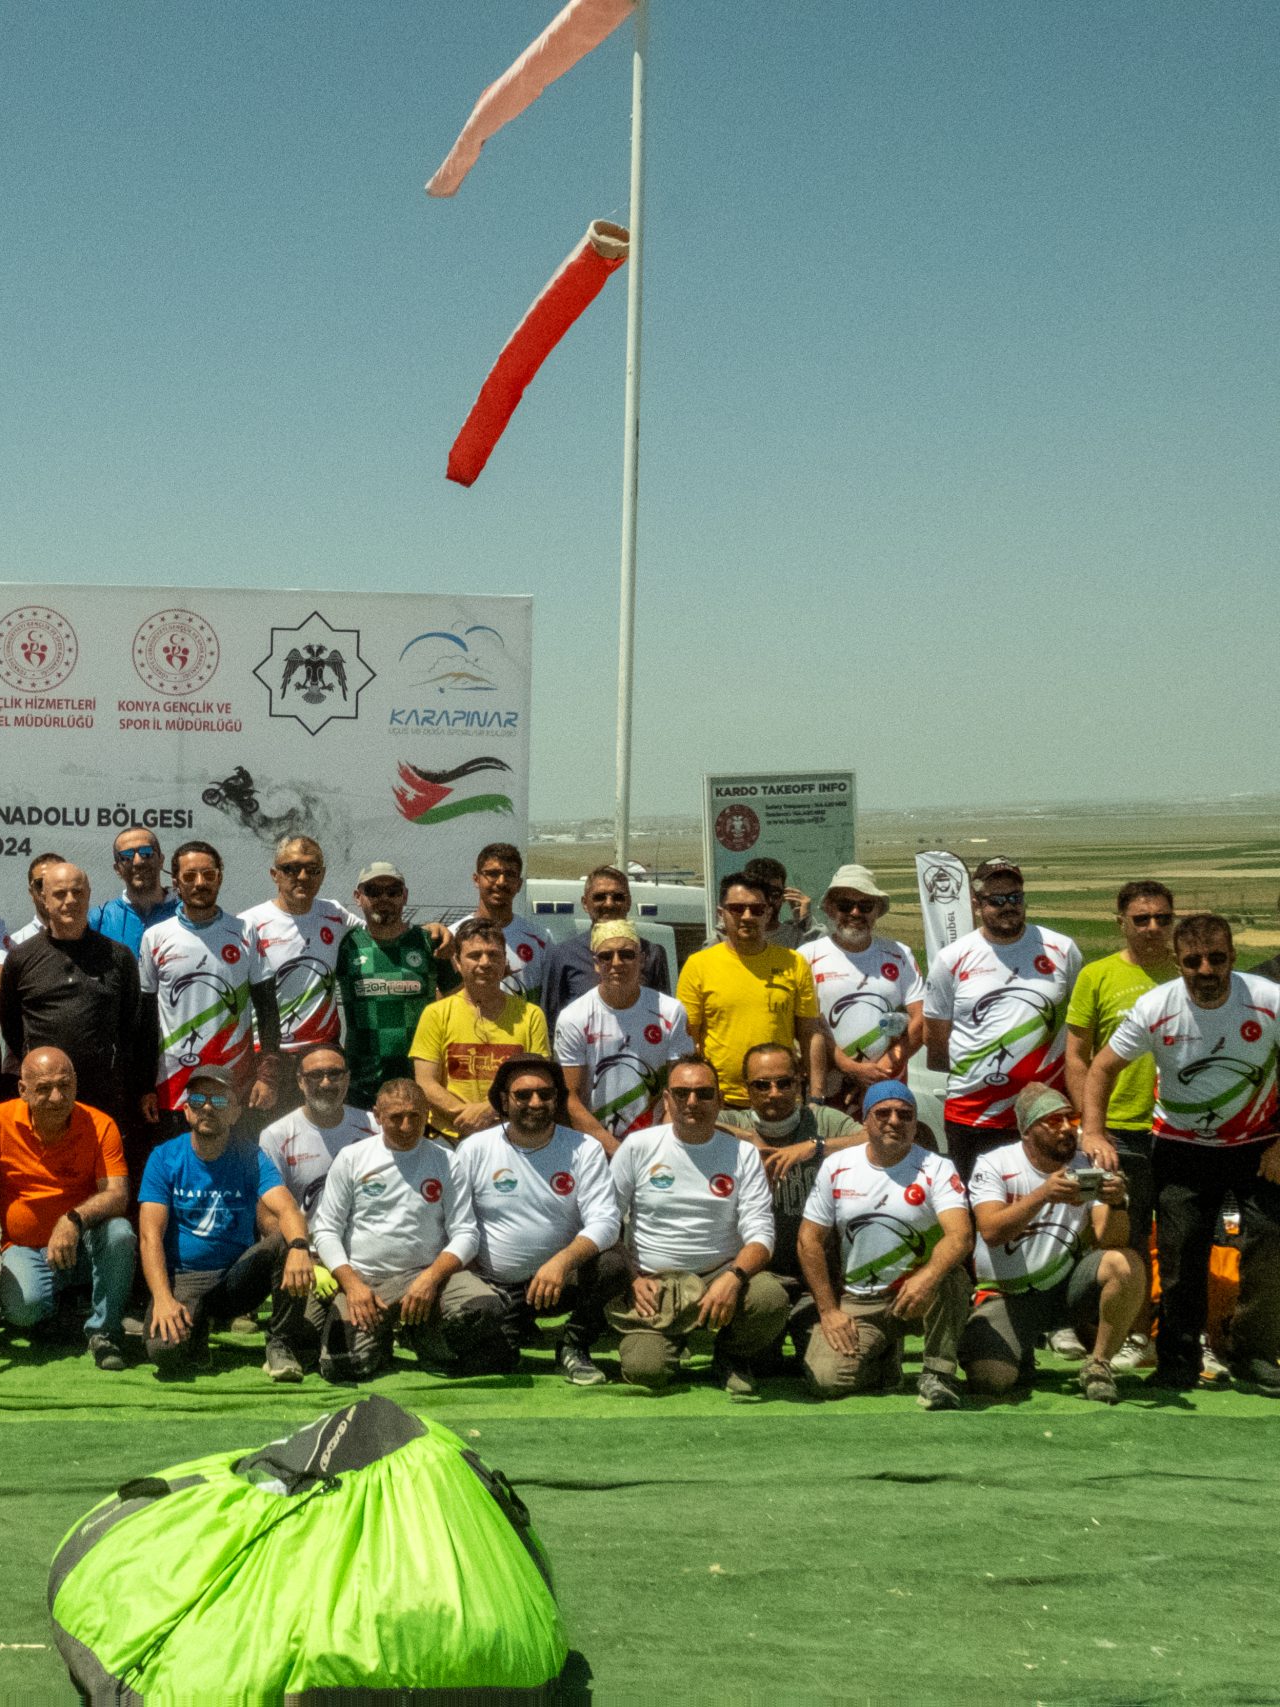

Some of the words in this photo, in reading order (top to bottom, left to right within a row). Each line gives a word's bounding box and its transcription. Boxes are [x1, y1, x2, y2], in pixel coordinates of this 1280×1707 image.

[24, 695, 96, 711] HİZMETLERİ
[118, 700, 161, 713] KONYA
[163, 700, 214, 716] GENÇLİK
[217, 702, 232, 714] VE
[13, 713, 94, 729] MÜDÜRLÜĞÜ
[119, 718, 150, 731] SPOR
[152, 717, 163, 731] İL
[165, 717, 242, 733] MÜDÜRLÜĞÜ
[389, 708, 519, 728] KARAPINAR
[715, 786, 758, 798] KARDO
[761, 784, 816, 796] TAKEOFF
[819, 782, 847, 794] INFO
[96, 803, 194, 829] BÖLGESİ
